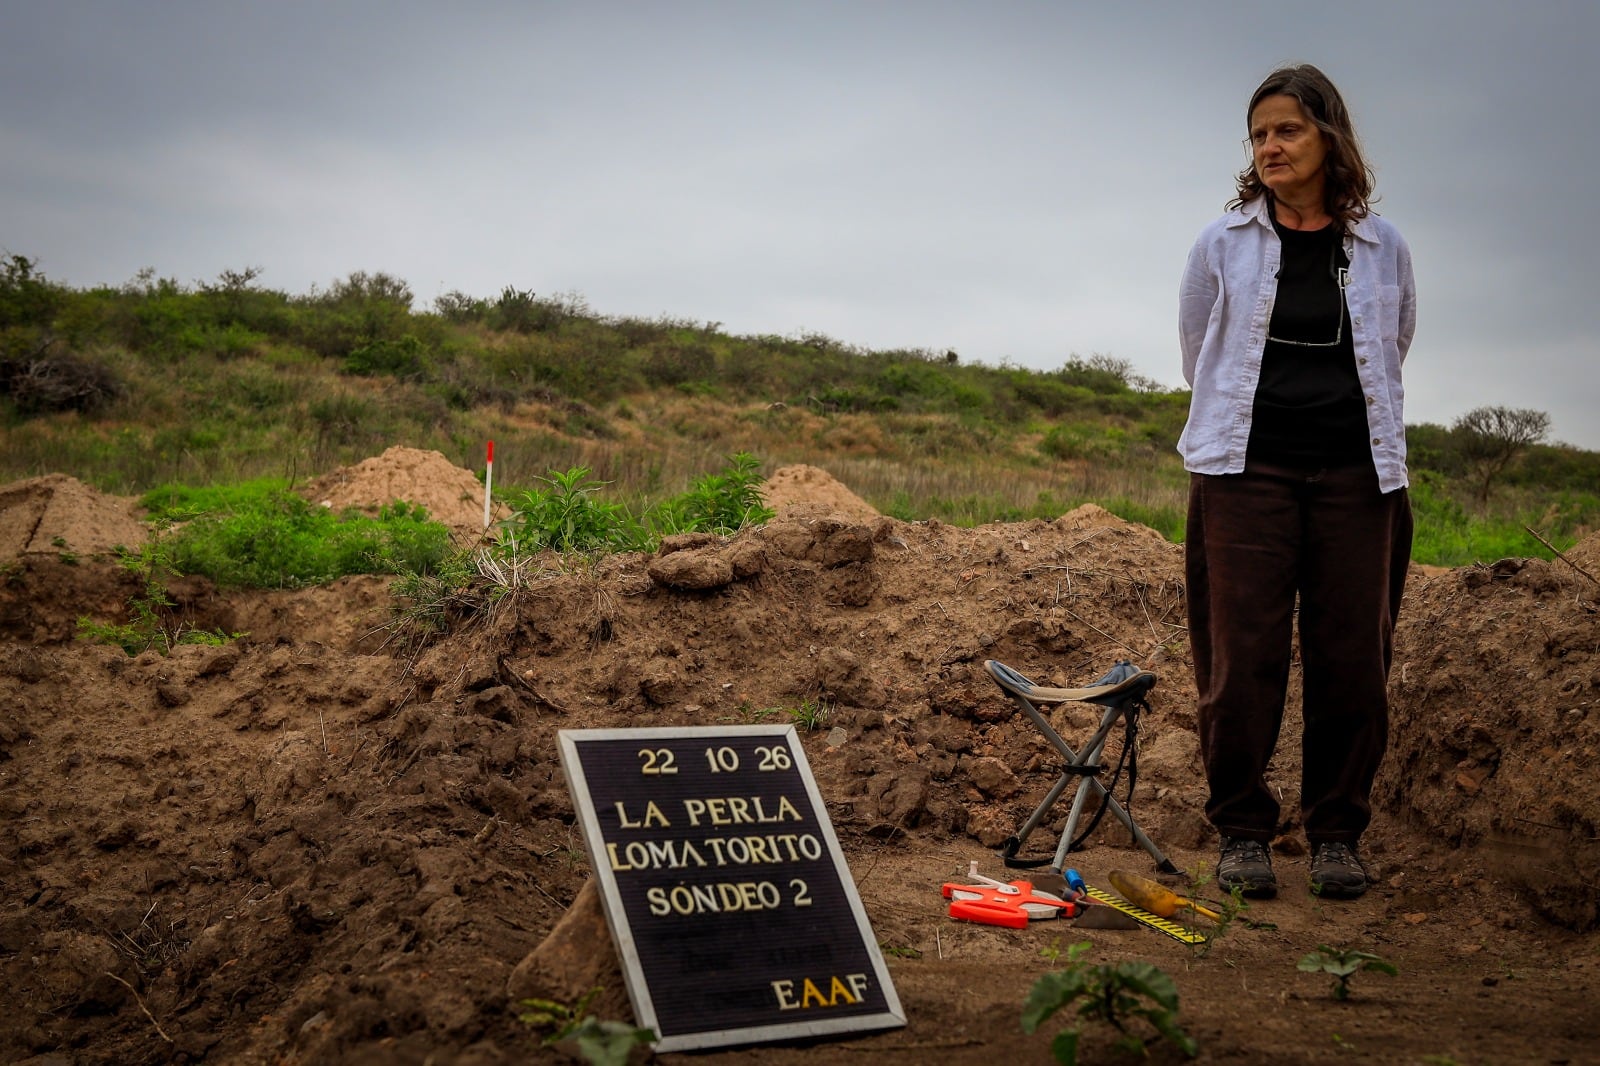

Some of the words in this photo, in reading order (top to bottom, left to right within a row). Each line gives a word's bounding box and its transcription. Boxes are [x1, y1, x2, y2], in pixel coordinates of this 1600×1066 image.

[638, 749, 679, 775] 22
[706, 747, 739, 773] 10
[755, 746, 791, 771] 26
[615, 801, 670, 829] LA
[684, 796, 802, 826] PERLA
[705, 834, 821, 863] TORITO
[790, 879, 812, 906] 2
[771, 973, 868, 1010] EAAF
